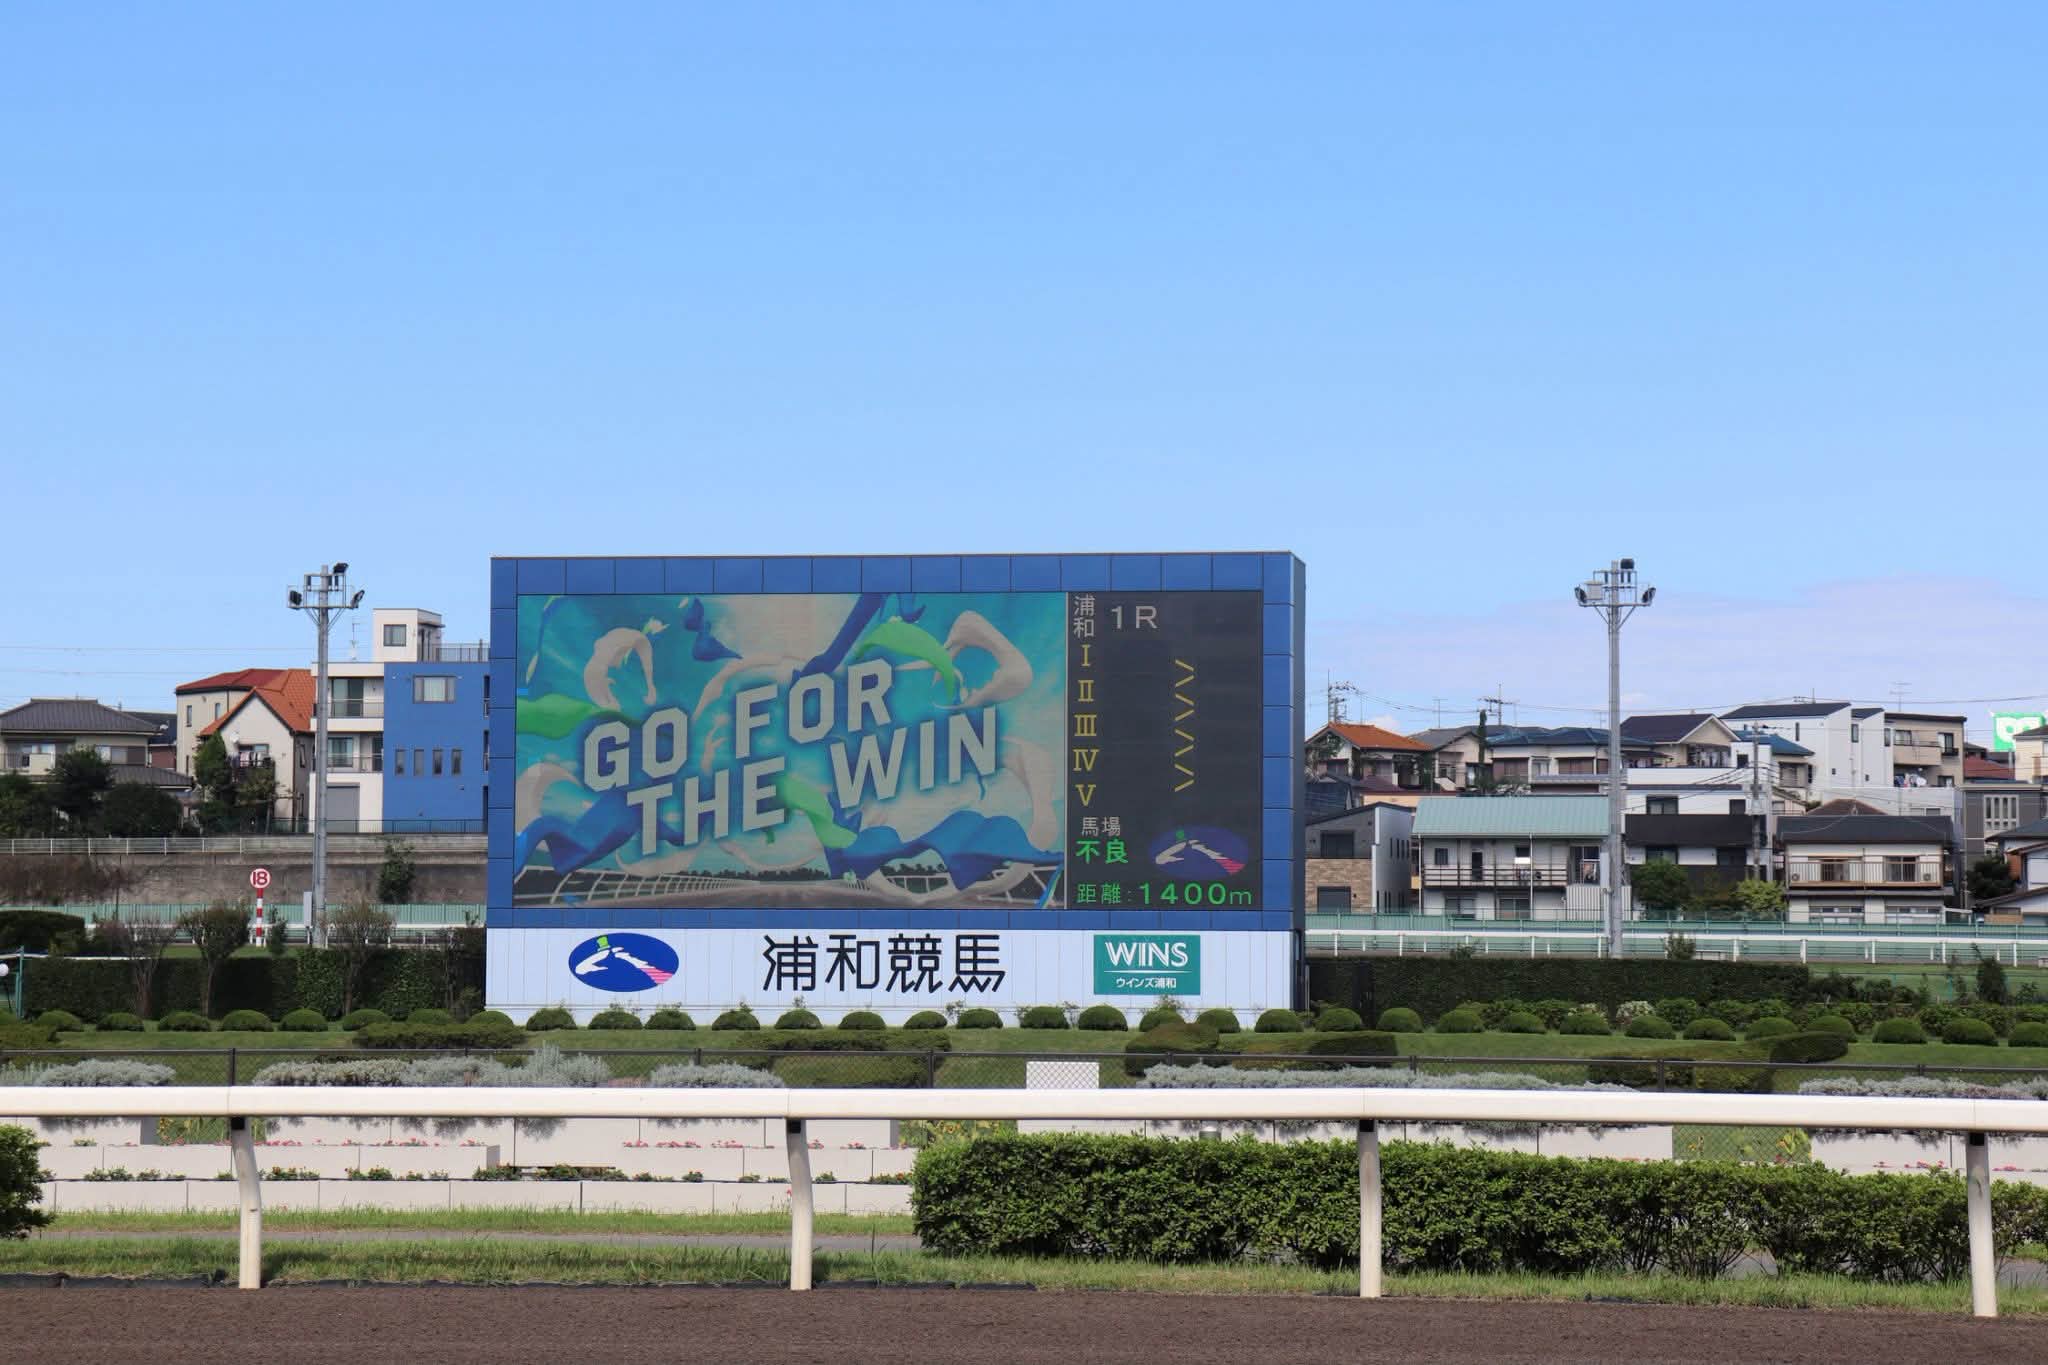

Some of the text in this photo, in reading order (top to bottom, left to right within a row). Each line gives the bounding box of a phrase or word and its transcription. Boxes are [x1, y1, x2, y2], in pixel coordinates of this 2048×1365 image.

[1073, 595, 1096, 638] 浦和
[1111, 605, 1158, 629] 1R
[584, 658, 892, 791] GO FOR
[626, 707, 997, 855] THE WIN
[1075, 783, 1096, 806] V
[1081, 816, 1121, 837] 馬場
[1075, 839, 1129, 864] 不良
[252, 871, 268, 885] 18
[1139, 882, 1252, 905] 1400m
[762, 933, 1007, 993] 浦和競馬
[1104, 941, 1189, 967] WINS
[1116, 976, 1177, 989] ウインズ浦和
